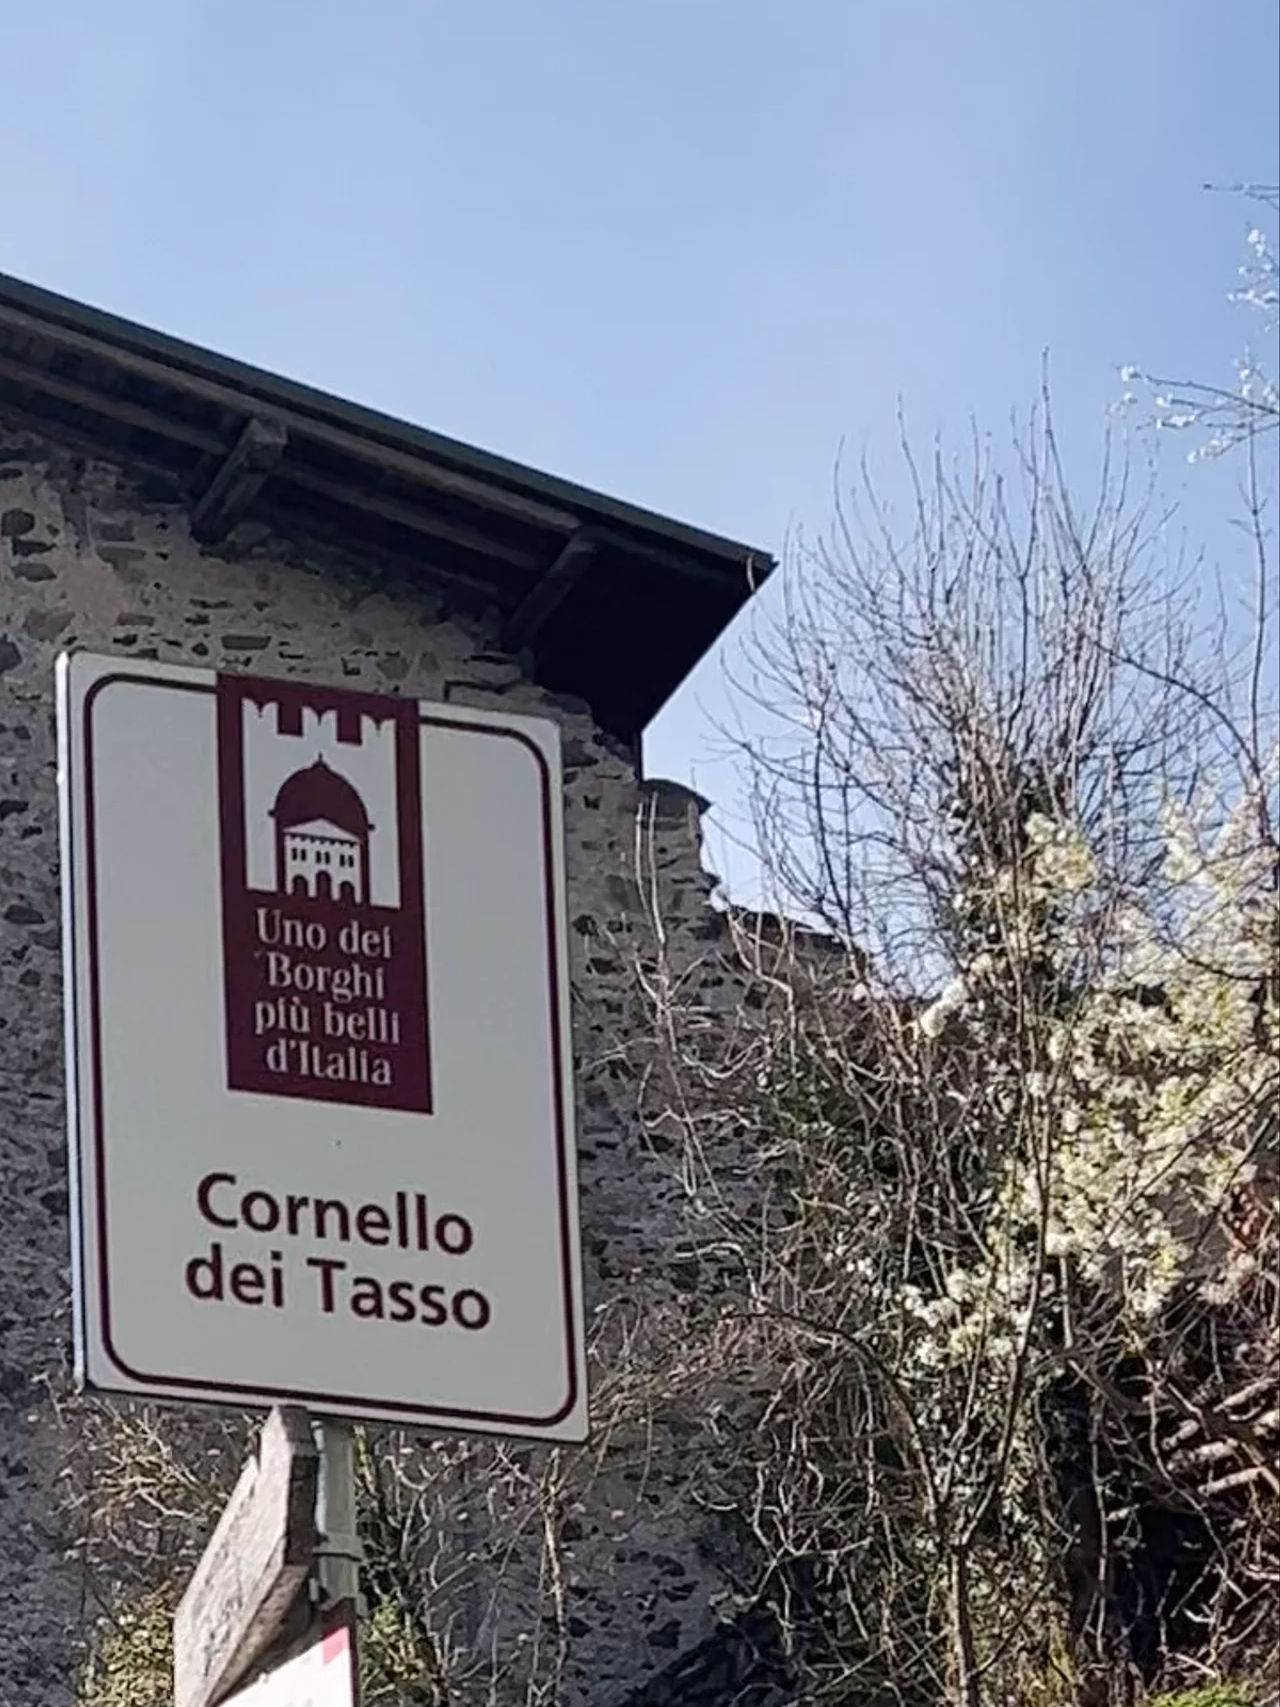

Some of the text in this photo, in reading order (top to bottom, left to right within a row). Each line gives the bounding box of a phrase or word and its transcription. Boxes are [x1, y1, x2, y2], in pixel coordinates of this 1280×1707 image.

[256, 908, 392, 958] Uno dei
[267, 951, 385, 1002] Borghi
[255, 996, 399, 1044] più belli
[267, 1038, 392, 1086] d'Italia
[196, 1172, 473, 1256] Cornello
[185, 1243, 491, 1331] dei Tasso
